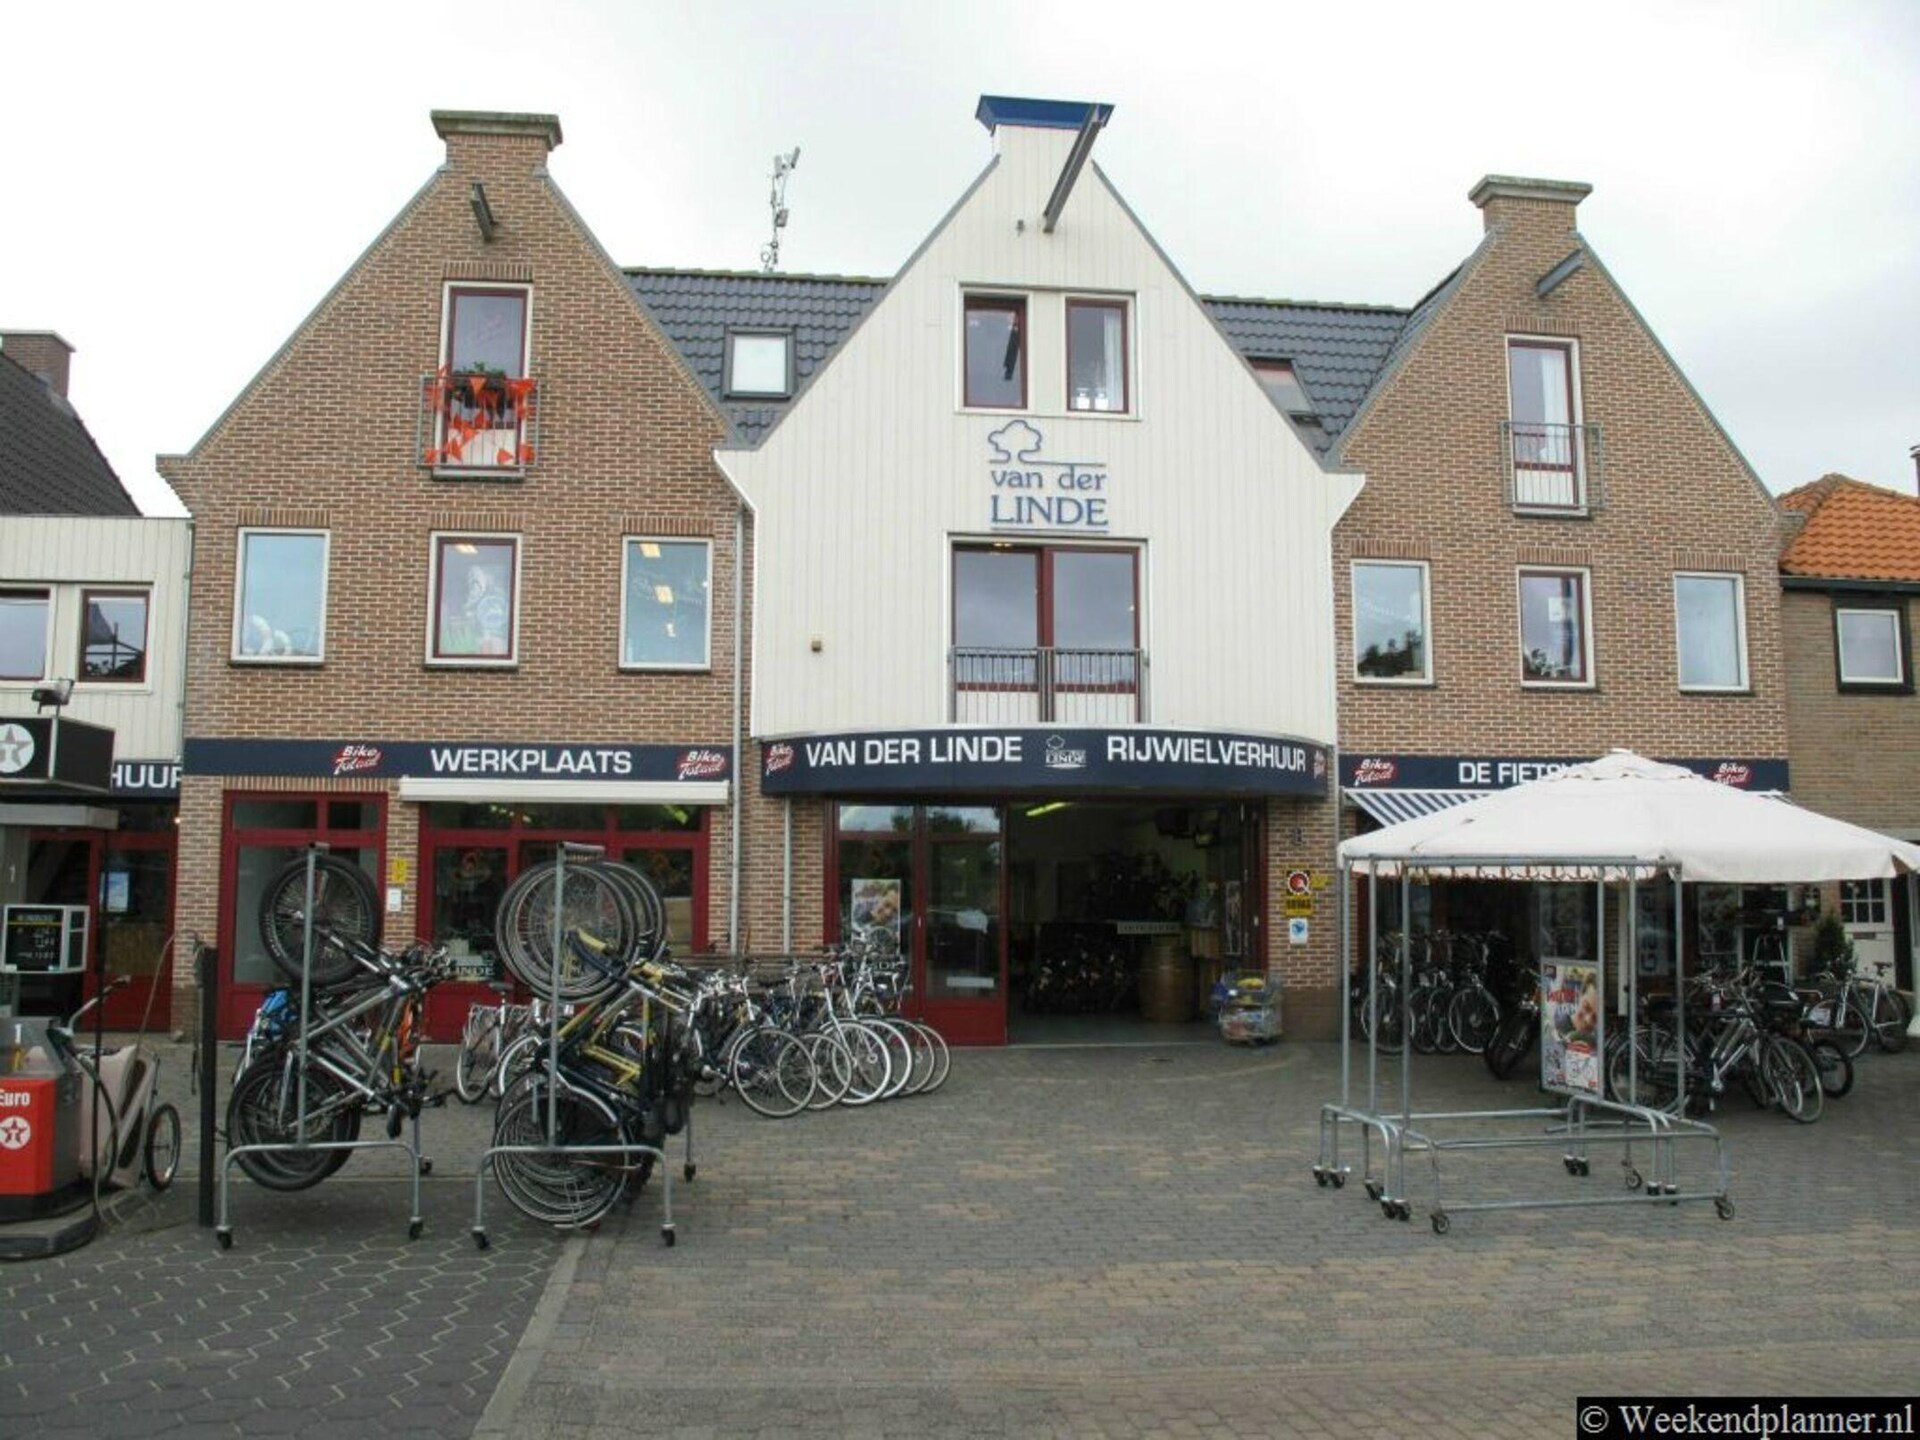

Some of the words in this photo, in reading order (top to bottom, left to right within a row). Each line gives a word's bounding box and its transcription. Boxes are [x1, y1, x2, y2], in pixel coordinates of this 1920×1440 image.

[991, 470, 1043, 489] van
[1058, 464, 1107, 490] der
[991, 495, 1109, 526] LINDE
[343, 744, 378, 757] Bike
[431, 748, 633, 774] WERKPLAATS
[686, 749, 722, 763] Bike
[806, 740, 856, 767] VAN
[864, 738, 920, 764] DER
[930, 736, 1023, 763] LINDE
[1107, 735, 1306, 772] RIJWIELVERHUUR
[1459, 762, 1491, 784] DE
